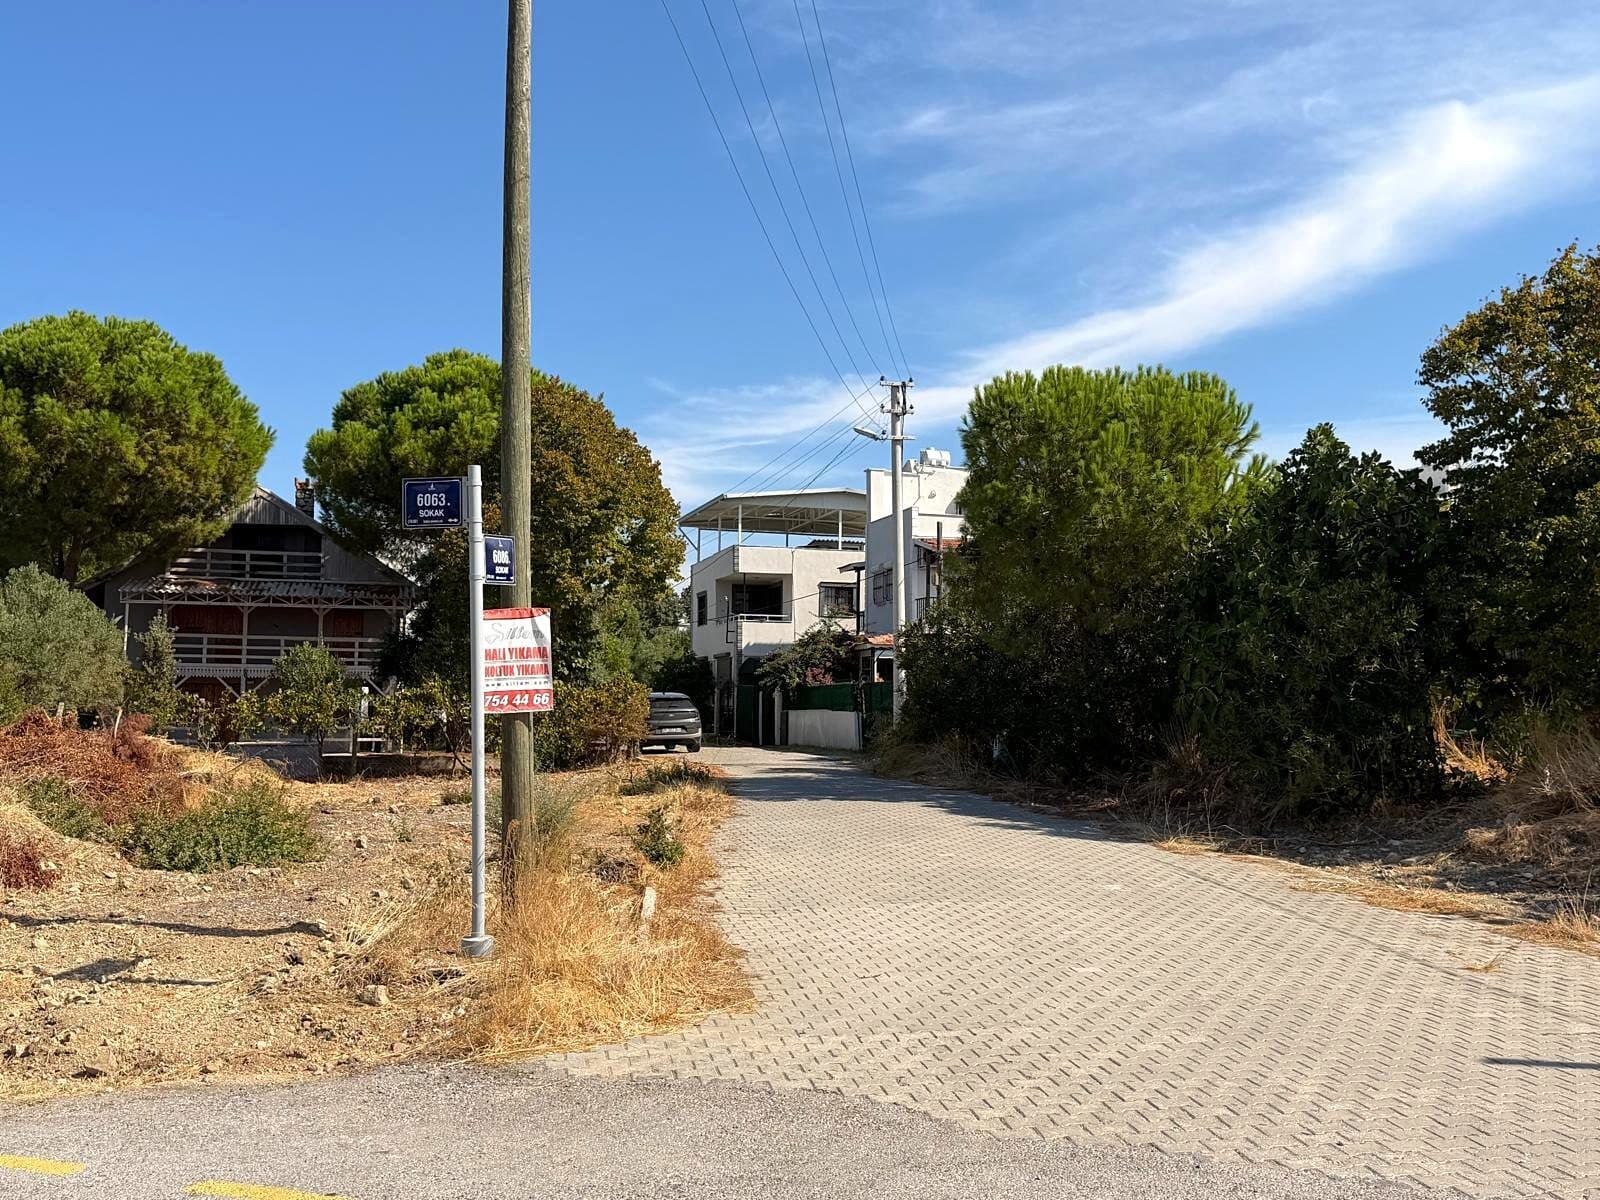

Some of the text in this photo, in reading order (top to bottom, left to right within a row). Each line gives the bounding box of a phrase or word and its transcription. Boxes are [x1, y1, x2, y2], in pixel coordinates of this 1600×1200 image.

[417, 493, 451, 507] 6063.
[419, 509, 445, 518] SOKAK
[484, 646, 549, 661] HALI YIKAMA
[484, 663, 550, 678] KOLTUK YIKAMA
[484, 692, 550, 707] 754 44 66
